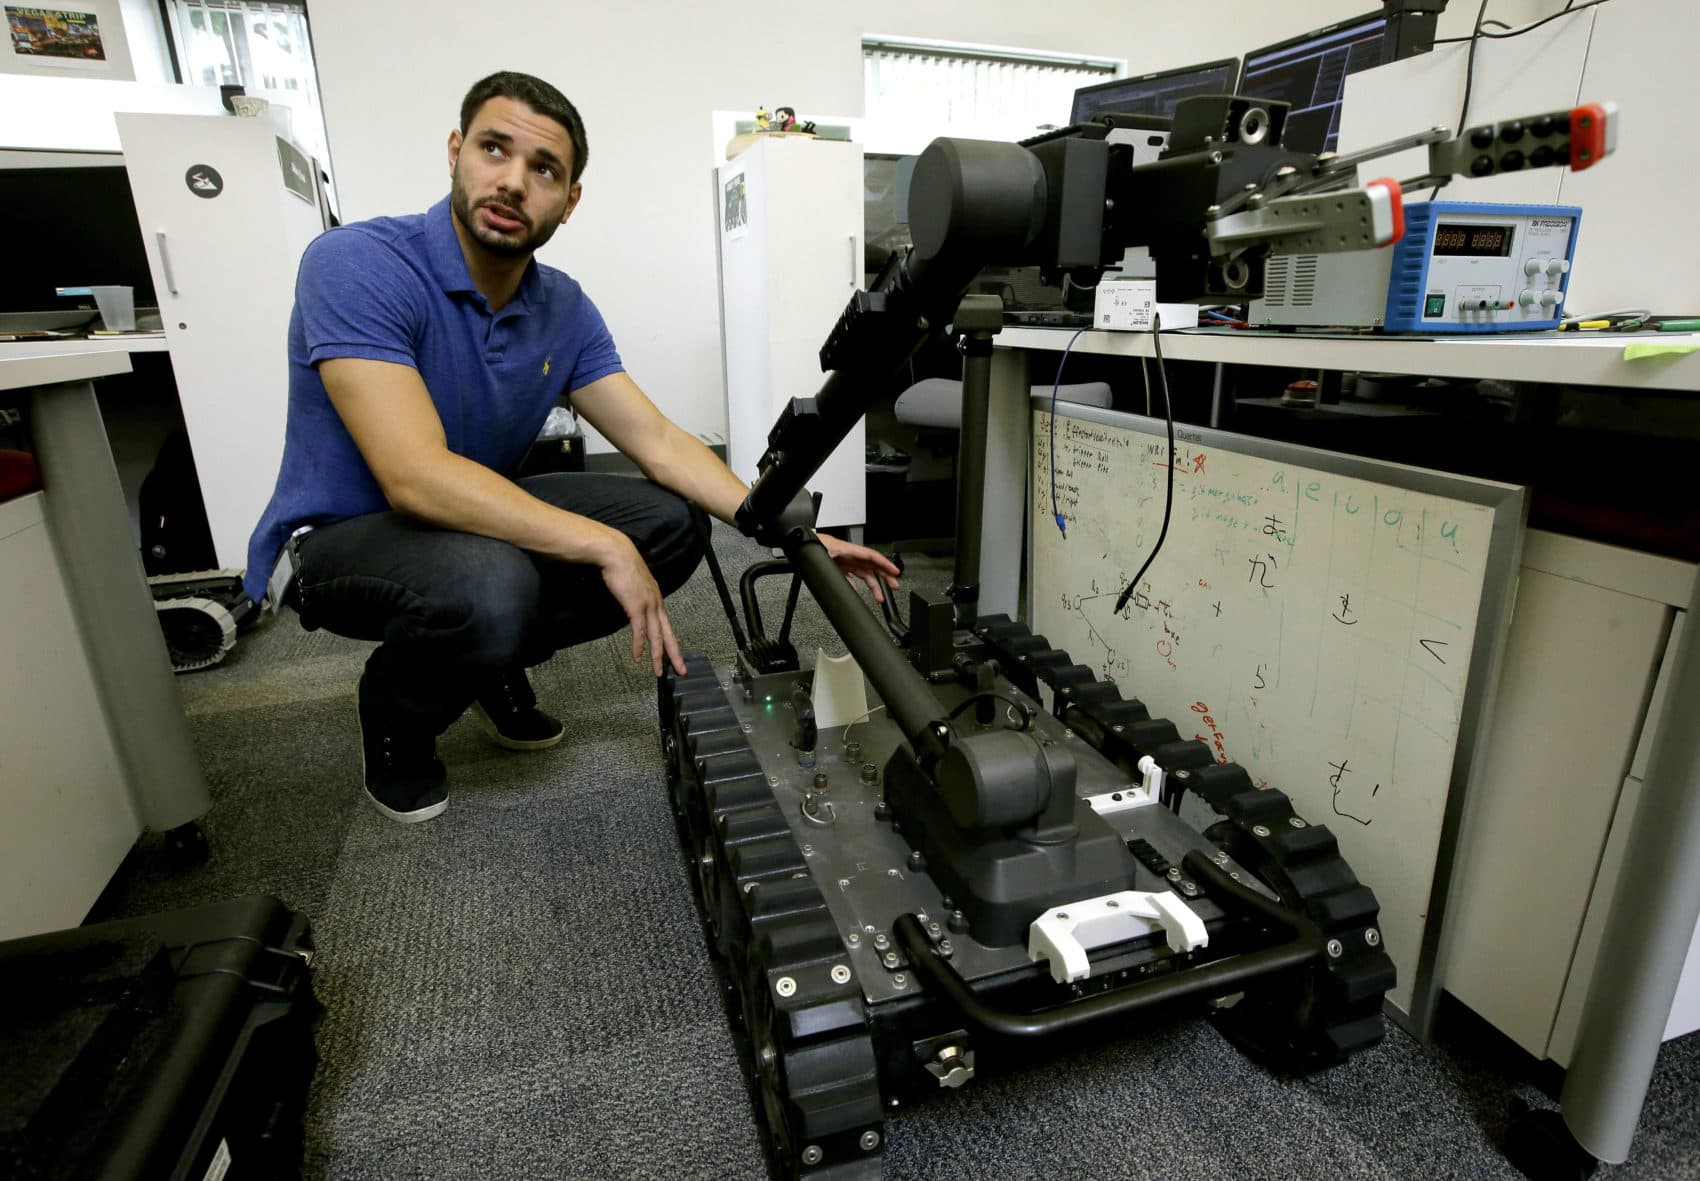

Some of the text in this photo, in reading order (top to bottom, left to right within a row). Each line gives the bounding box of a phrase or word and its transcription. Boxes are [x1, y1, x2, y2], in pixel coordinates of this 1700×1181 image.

[16, 7, 87, 20] VEGAS STRIP
[1305, 482, 1321, 501] e
